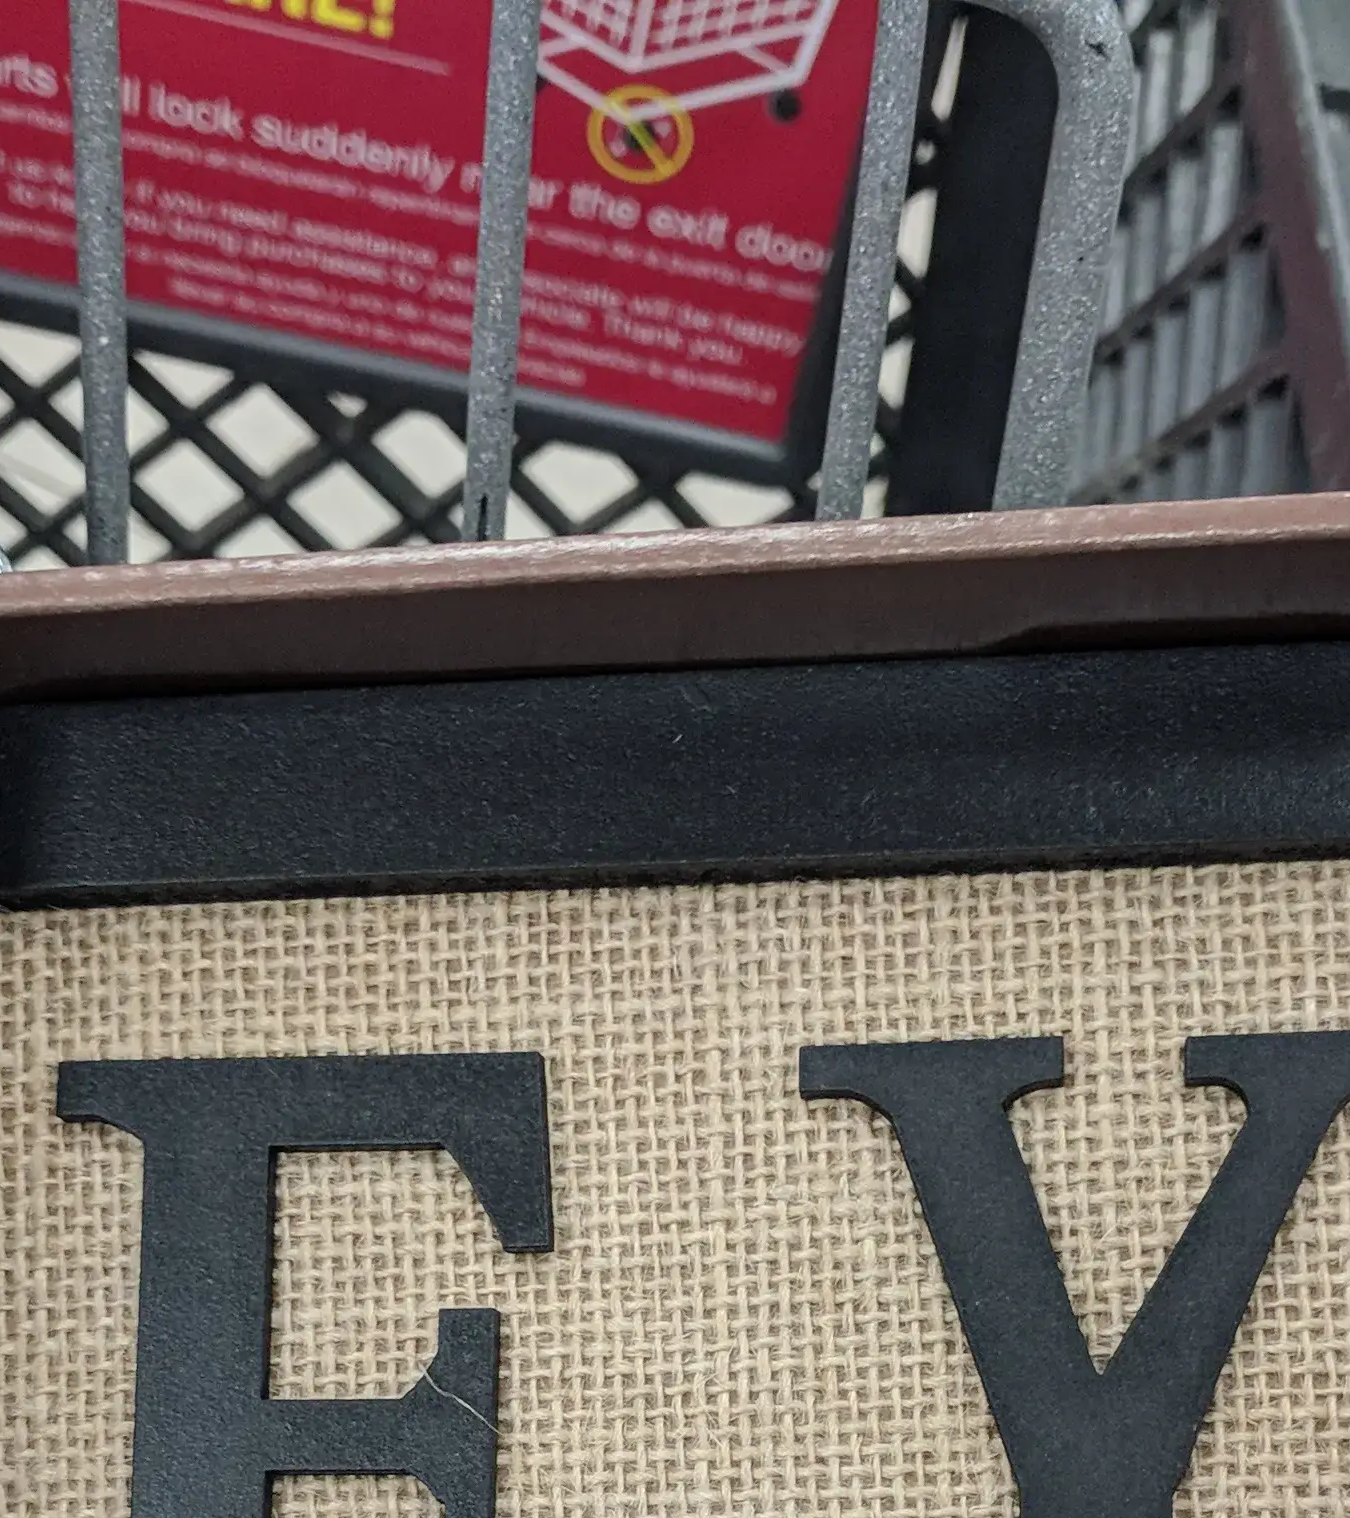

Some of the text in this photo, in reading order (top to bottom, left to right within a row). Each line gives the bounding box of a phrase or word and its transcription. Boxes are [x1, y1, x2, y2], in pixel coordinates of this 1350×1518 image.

[149, 81, 245, 141] lock
[251, 115, 455, 194] suddenly
[567, 180, 641, 230] the
[647, 204, 730, 252] exit
